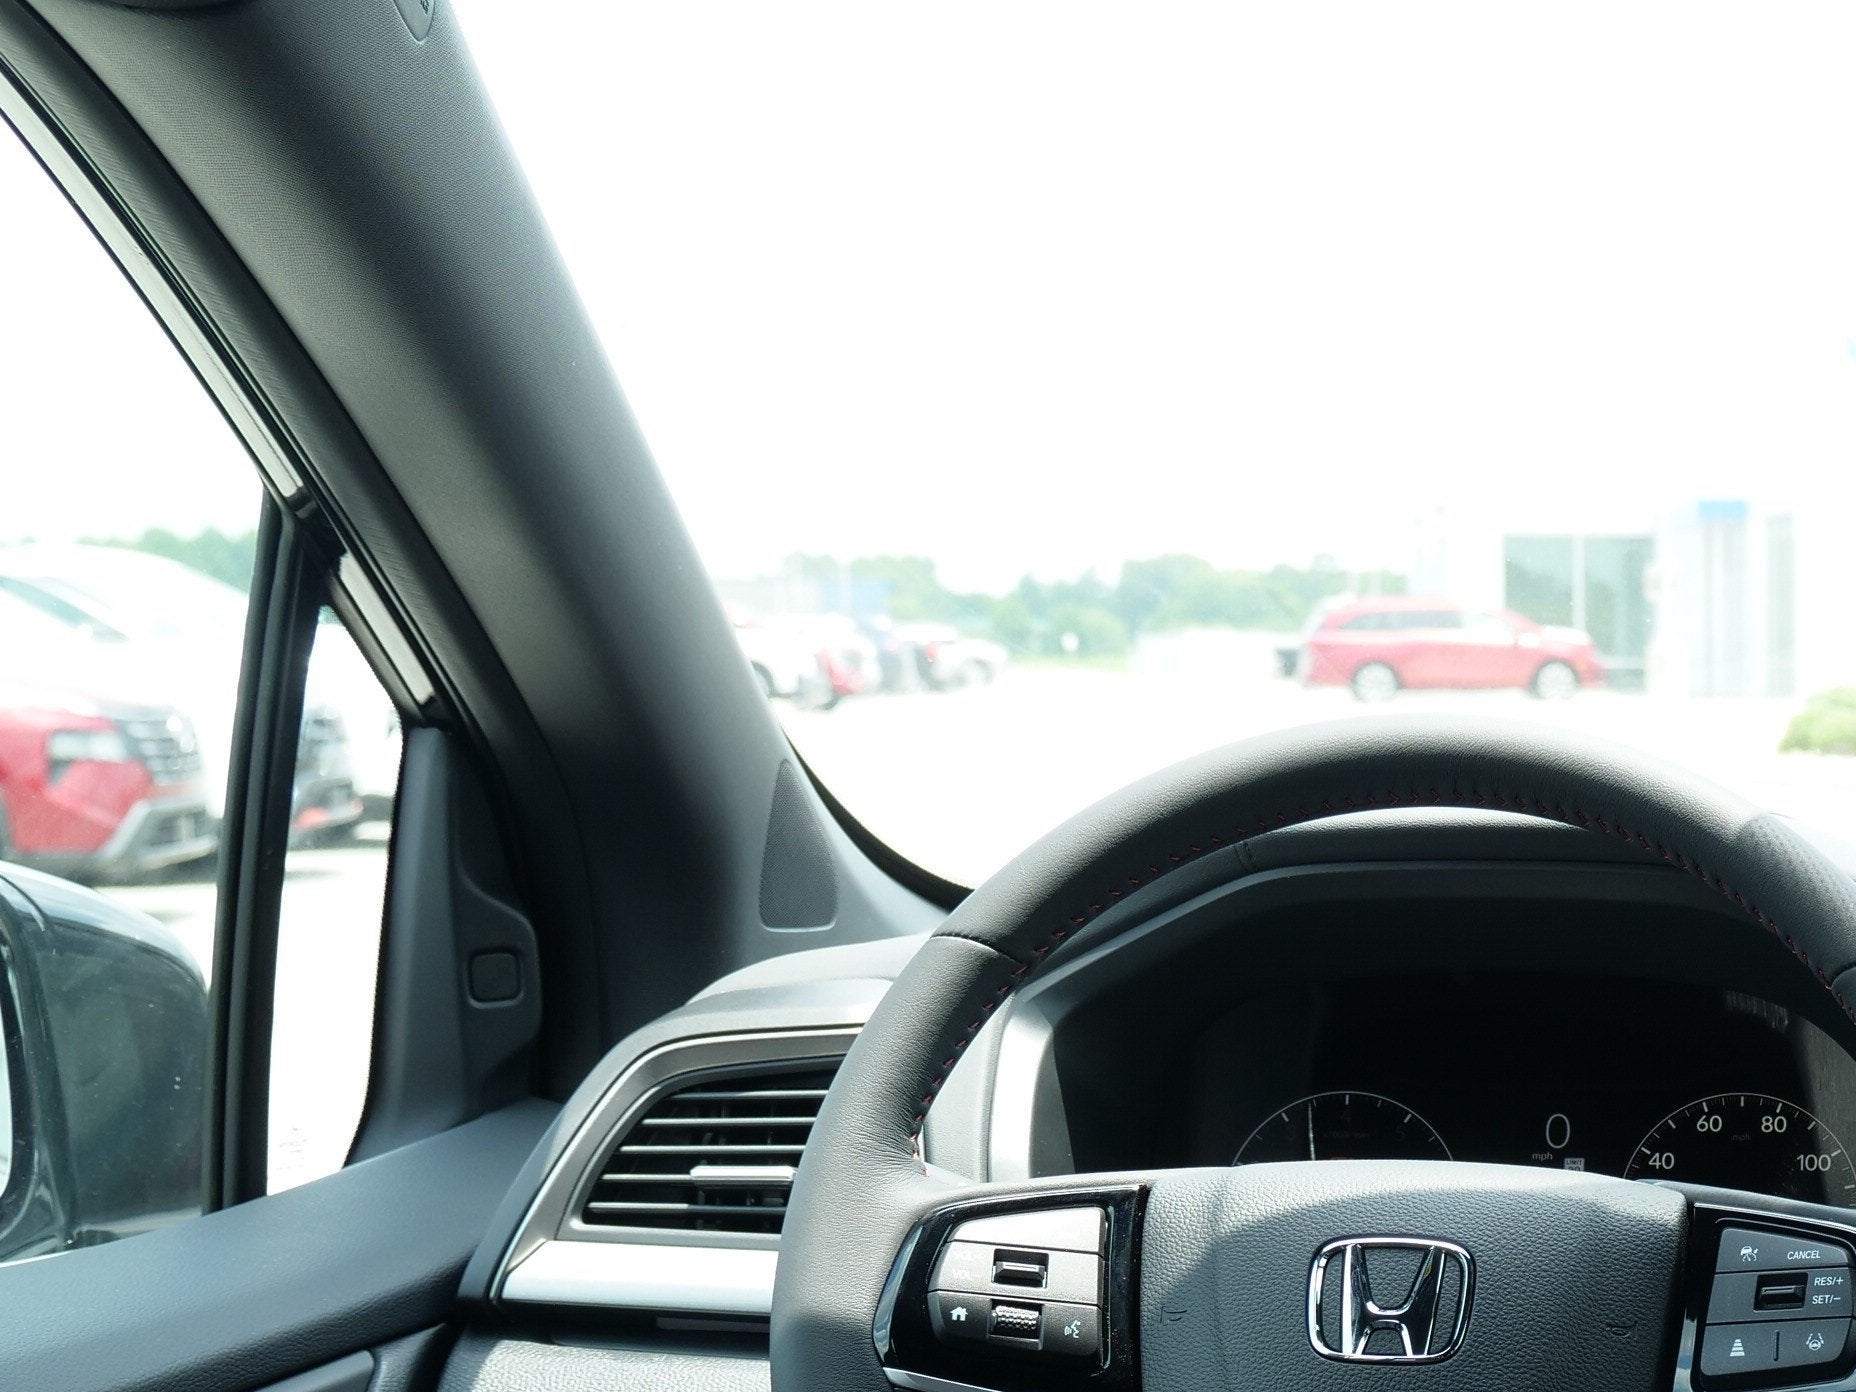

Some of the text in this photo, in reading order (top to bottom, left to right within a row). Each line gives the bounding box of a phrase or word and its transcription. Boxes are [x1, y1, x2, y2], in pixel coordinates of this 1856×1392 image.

[1696, 1116, 1722, 1133] 60
[1761, 1116, 1787, 1133] 80
[1532, 1152, 1553, 1161] mph
[1649, 1152, 1675, 1170] 40
[1798, 1154, 1831, 1172] 100
[1787, 1250, 1821, 1260] CANCEL
[1814, 1276, 1844, 1286] RES/+
